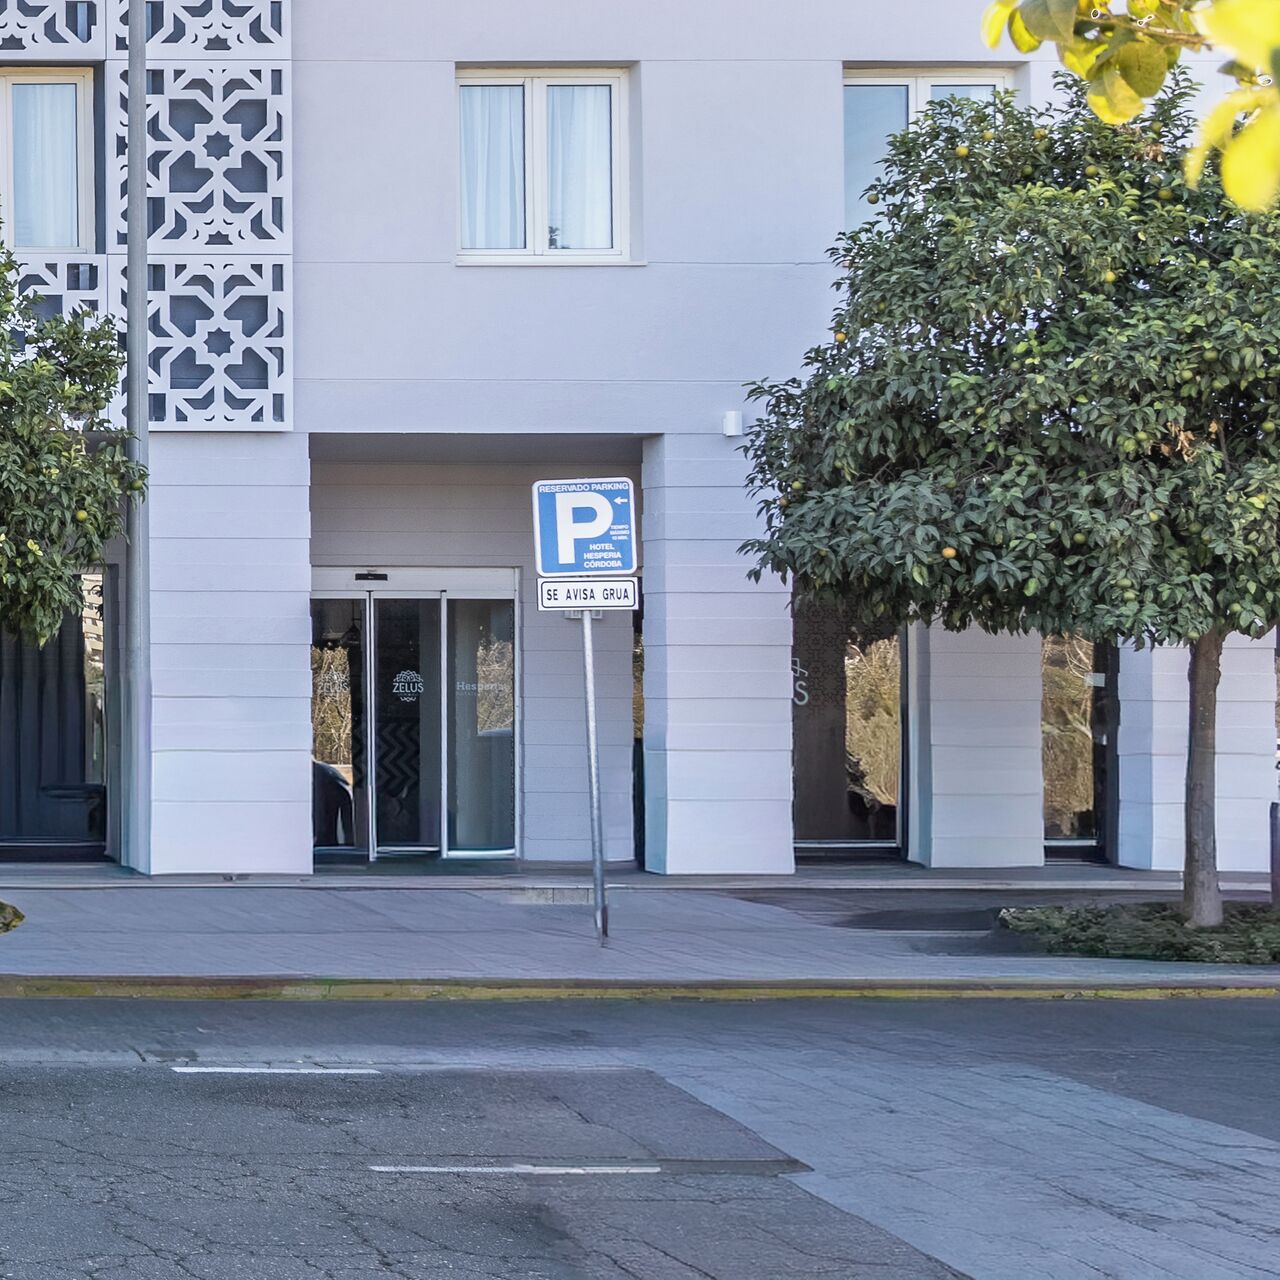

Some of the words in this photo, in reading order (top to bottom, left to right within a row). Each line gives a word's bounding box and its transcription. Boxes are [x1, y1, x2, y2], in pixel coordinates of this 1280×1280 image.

[539, 484, 590, 493] RESERVADO
[591, 482, 629, 491] PARKING
[555, 491, 613, 564] P
[584, 551, 622, 559] HESPERIA
[584, 559, 622, 568] CÓRDOBA
[546, 589, 559, 601] SE
[566, 589, 595, 601] AVISA
[602, 589, 630, 601] GRUA
[392, 682, 424, 693] ZELUS
